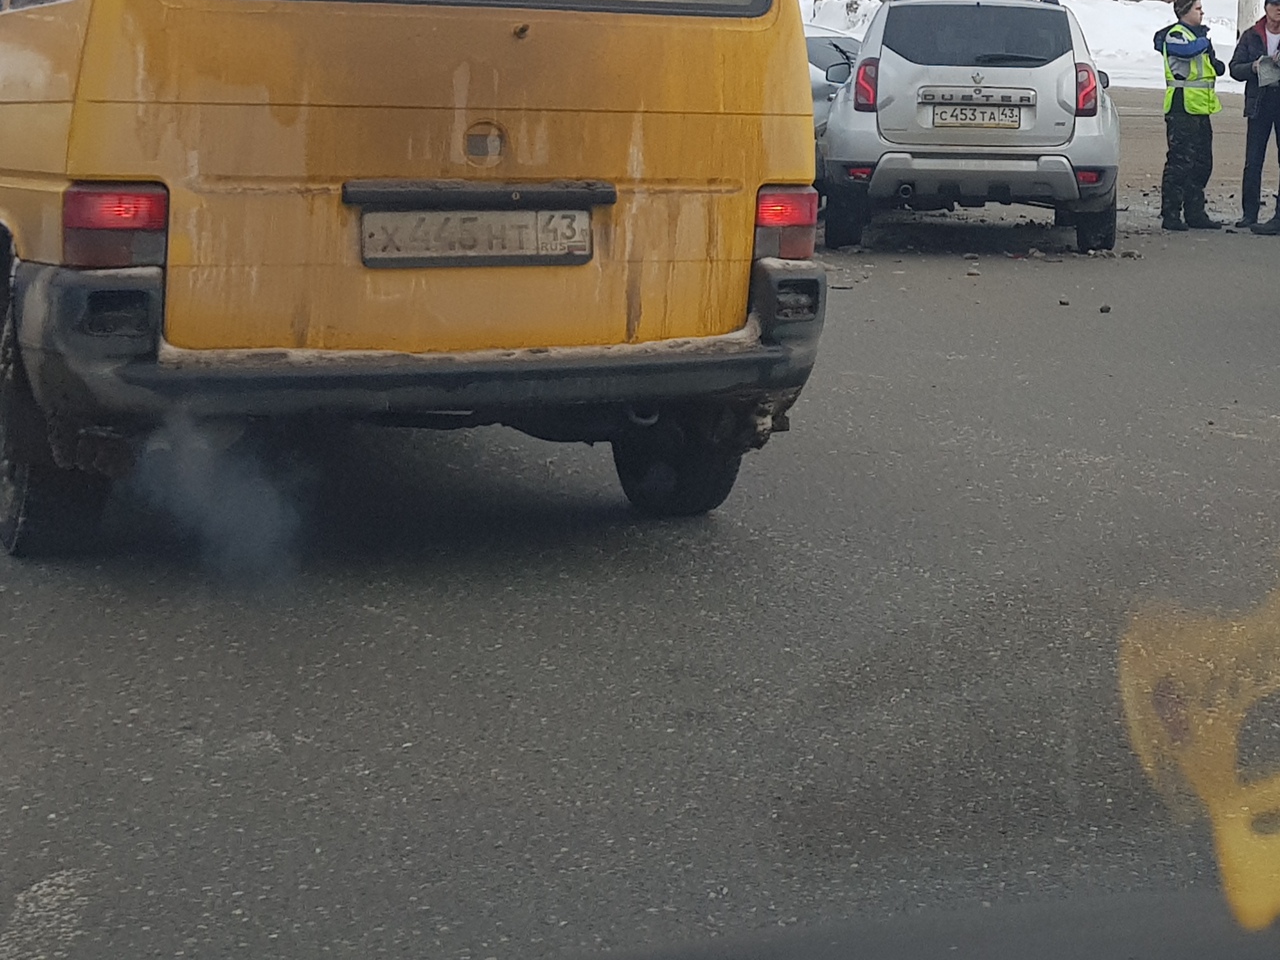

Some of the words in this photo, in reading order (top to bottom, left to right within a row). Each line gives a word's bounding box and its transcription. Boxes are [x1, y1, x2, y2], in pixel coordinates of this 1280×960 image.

[924, 93, 1031, 103] DUSTER
[1001, 108, 1015, 119] 43
[541, 214, 577, 241] 43
[541, 242, 567, 251] RUS
